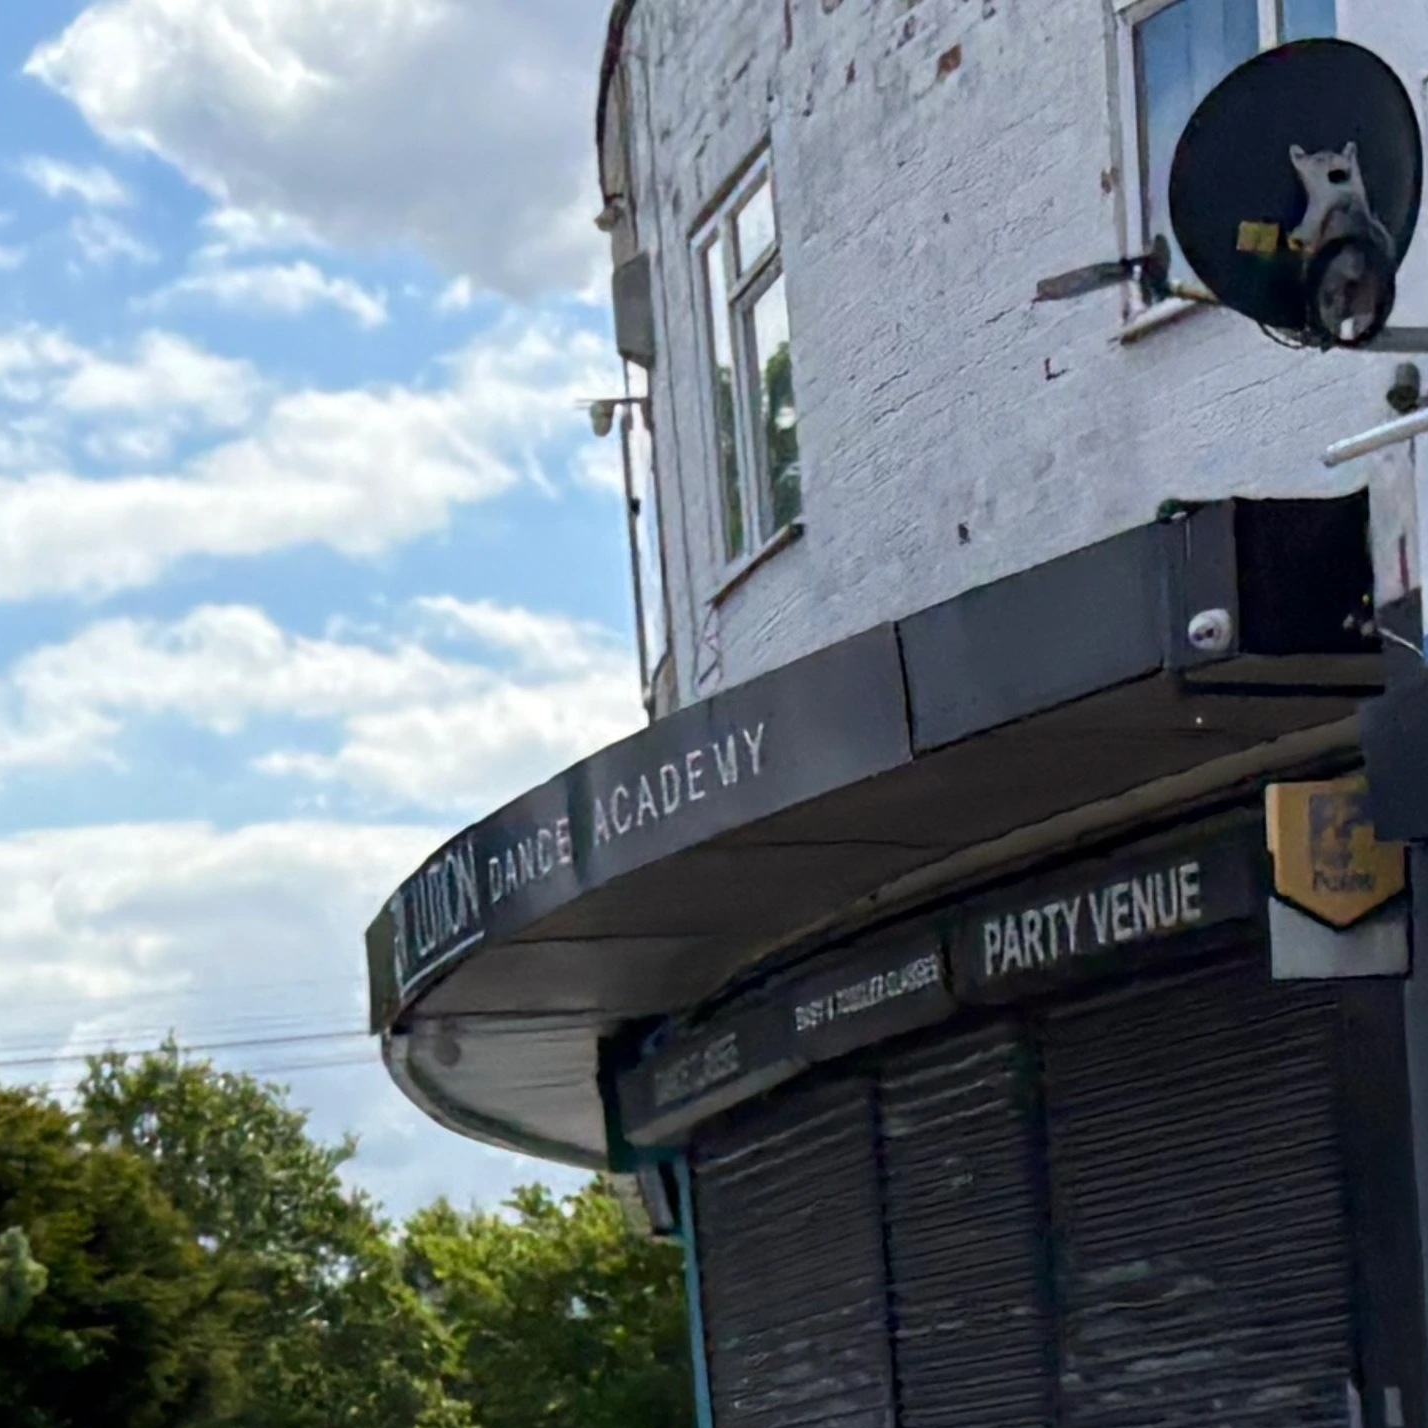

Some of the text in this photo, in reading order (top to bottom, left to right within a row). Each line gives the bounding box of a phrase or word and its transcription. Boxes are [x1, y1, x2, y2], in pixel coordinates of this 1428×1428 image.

[488, 816, 572, 904] DANCE
[592, 721, 765, 849] ACADEMY
[983, 861, 1202, 977] PARTY VENUE
